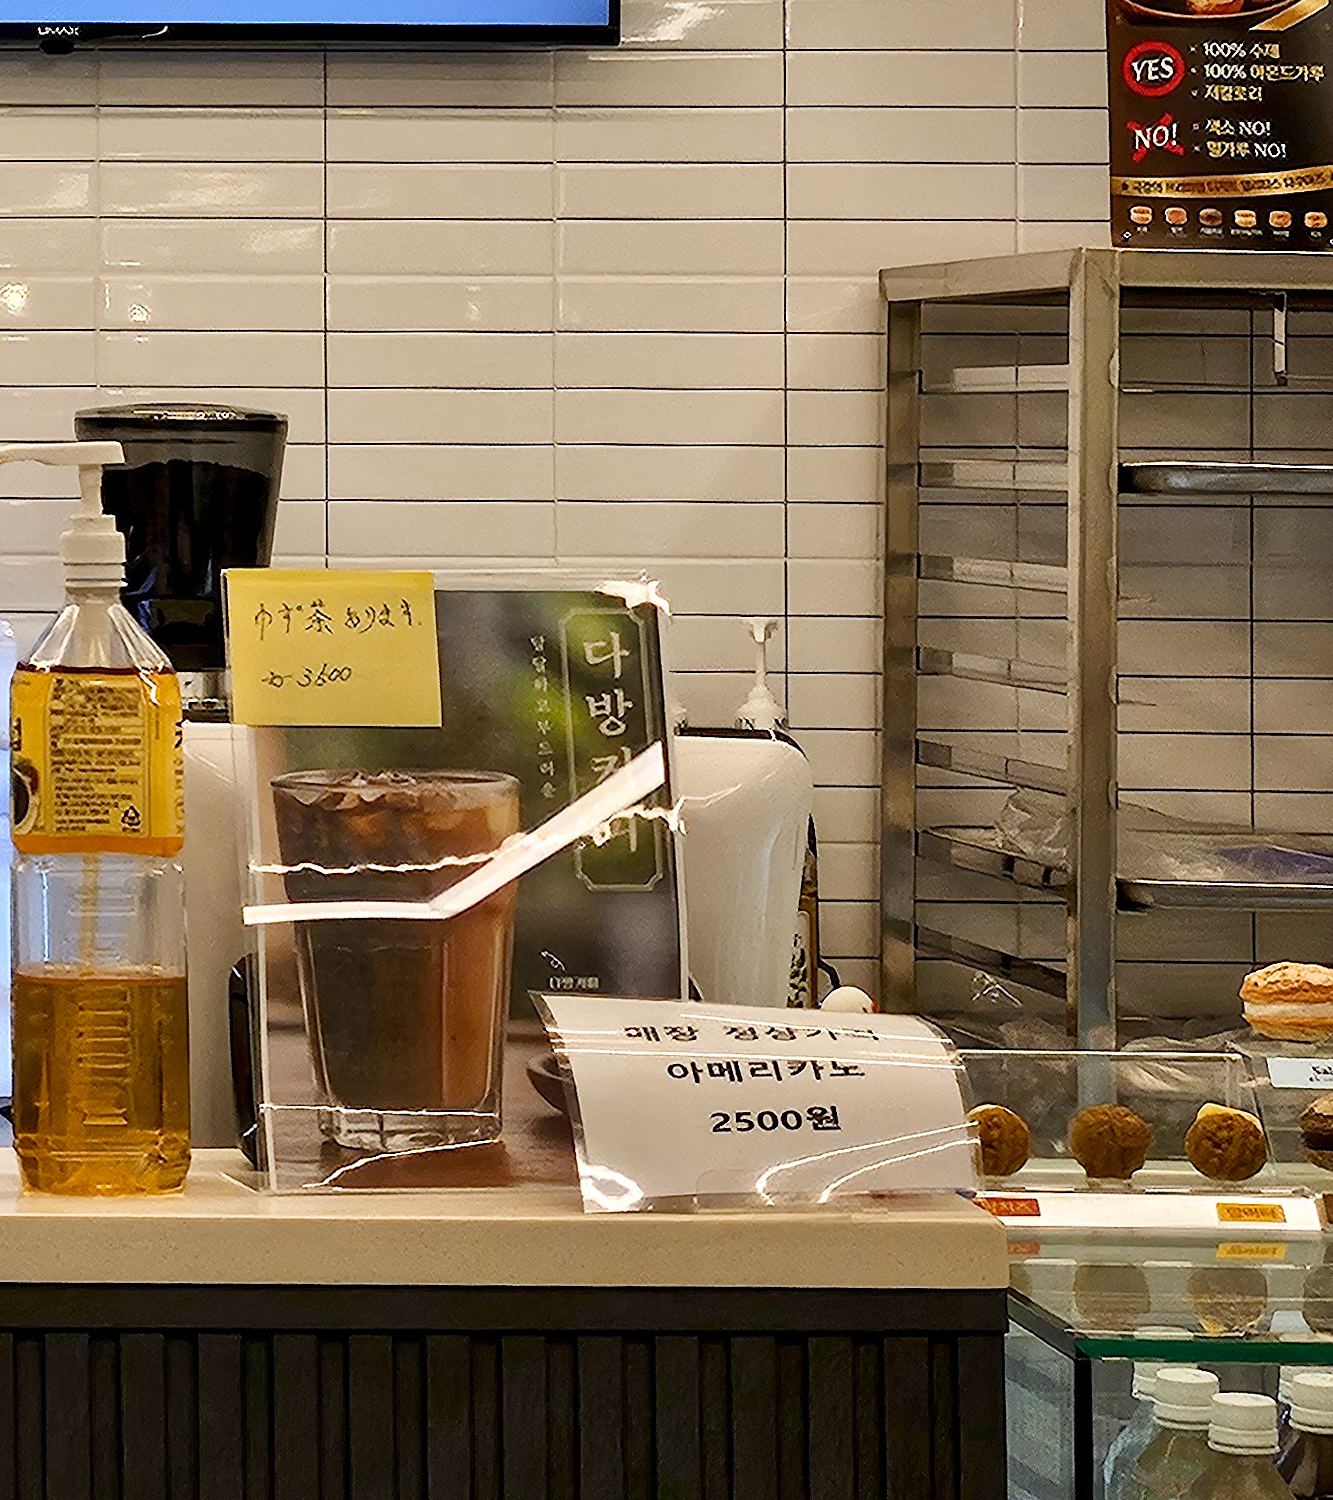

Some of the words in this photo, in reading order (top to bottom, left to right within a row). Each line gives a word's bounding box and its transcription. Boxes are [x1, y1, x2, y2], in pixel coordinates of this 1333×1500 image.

[1203, 42, 1247, 58] 100%
[1131, 56, 1174, 82] YES
[1203, 64, 1247, 79] 100%
[1134, 122, 1177, 150] NO!
[1238, 120, 1271, 136] NO!
[1253, 143, 1286, 158] NO!
[583, 630, 638, 852] 다방커
[667, 1060, 866, 1083] 아메리카노
[709, 1105, 842, 1134] 2500원
